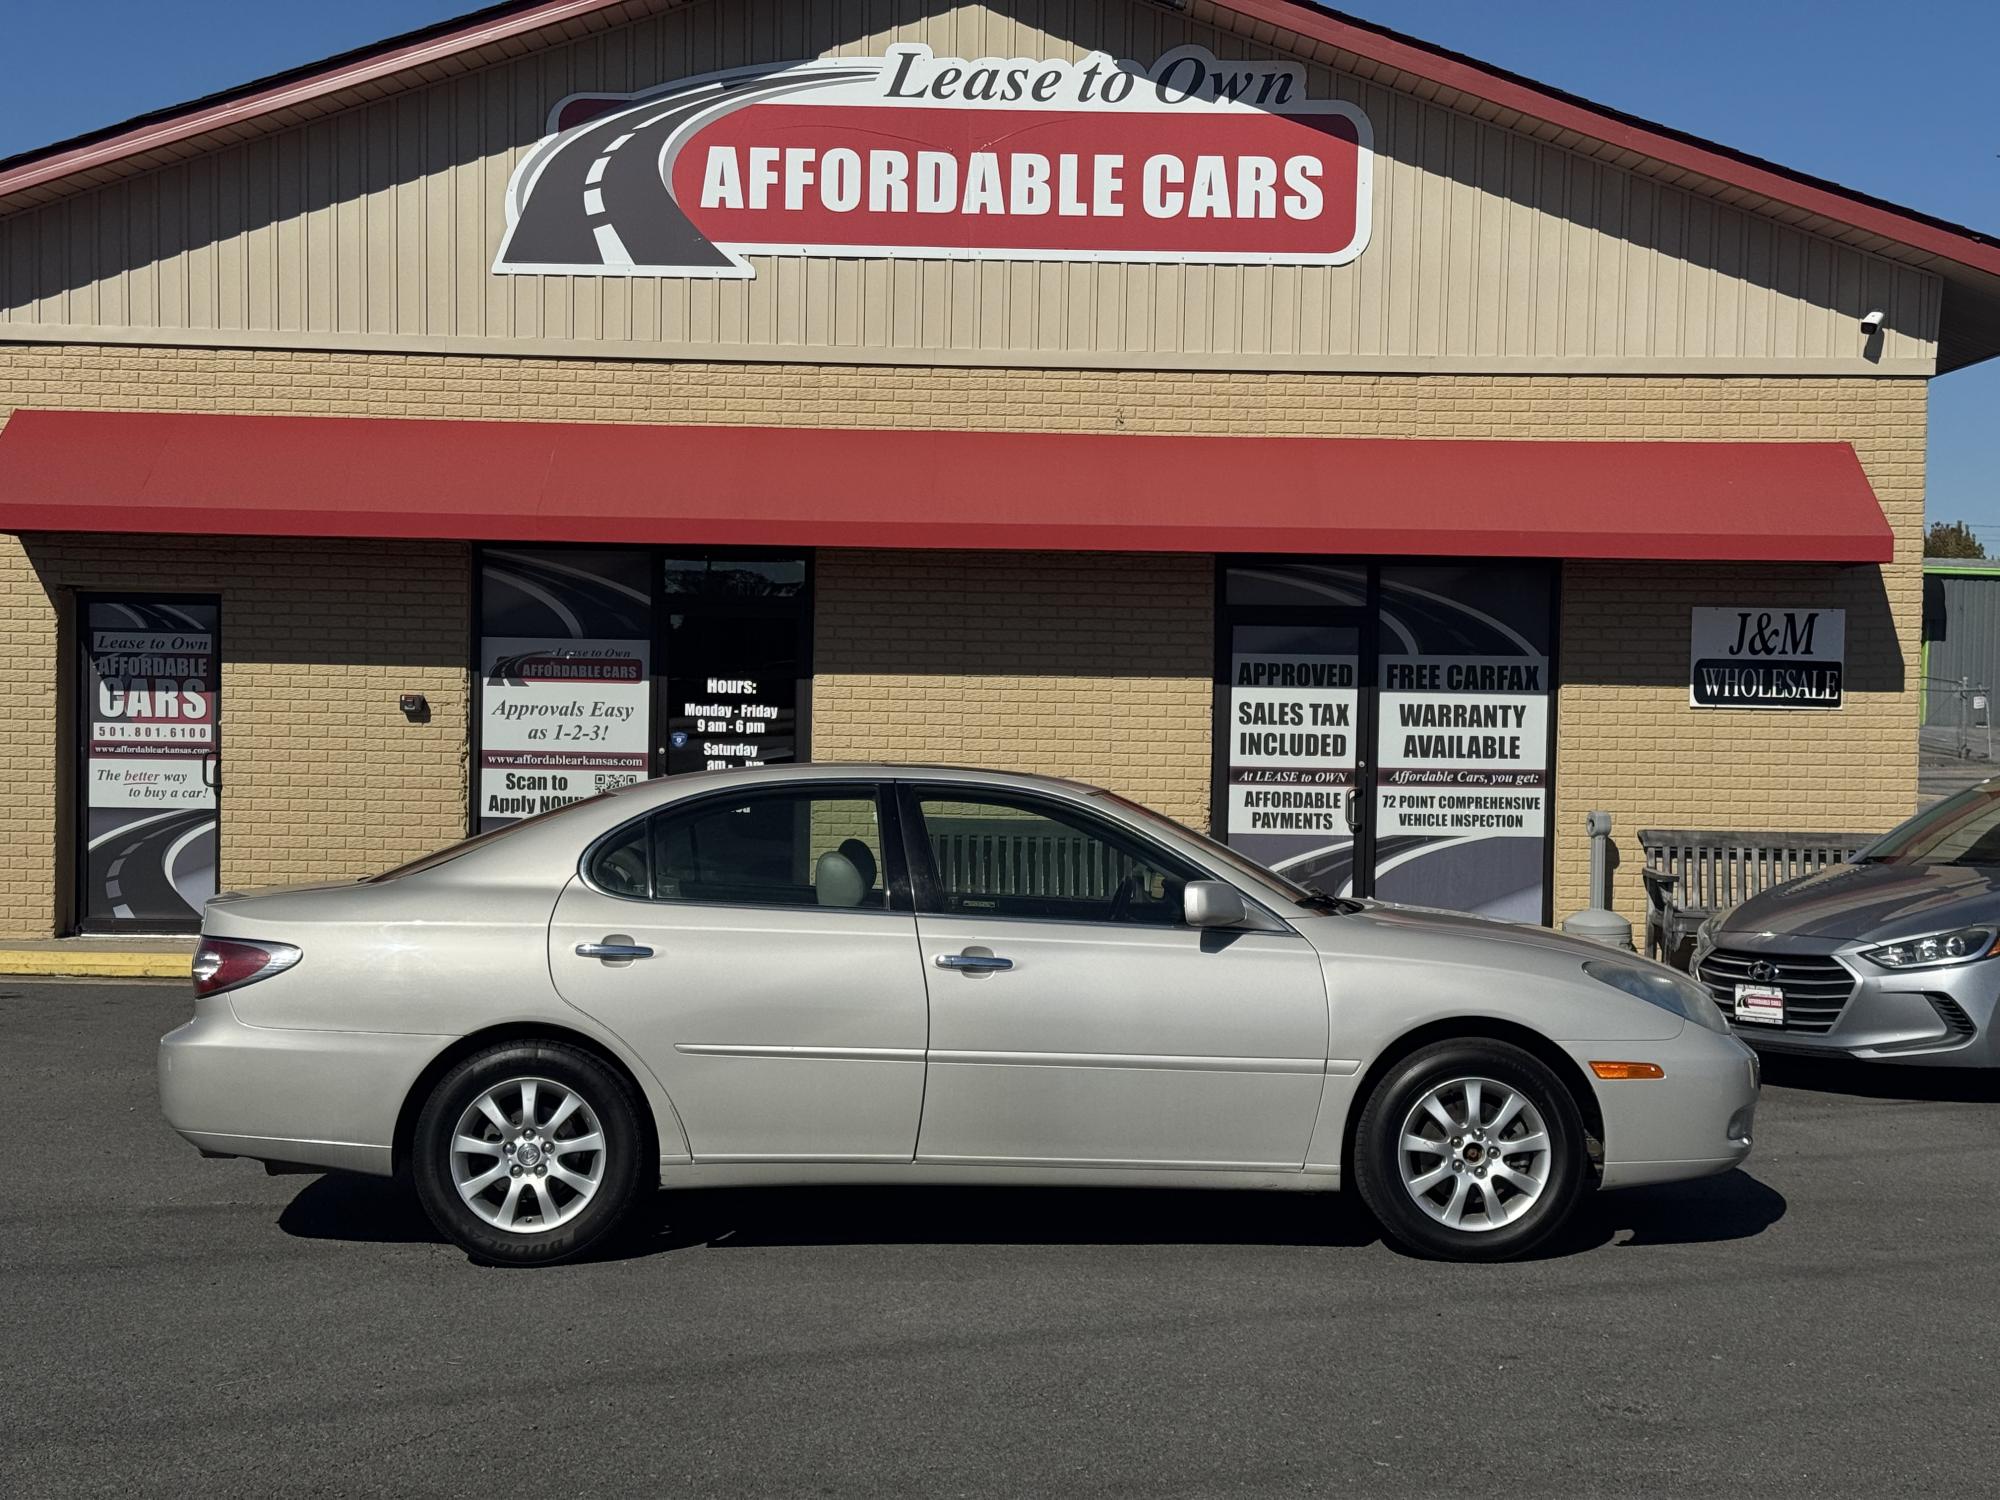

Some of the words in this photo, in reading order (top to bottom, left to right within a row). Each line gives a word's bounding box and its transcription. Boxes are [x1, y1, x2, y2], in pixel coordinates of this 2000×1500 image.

[884, 52, 1062, 101] Lease
[1078, 61, 1134, 103] to
[1156, 63, 1297, 105] Own
[700, 146, 1124, 217] AFFORDABLE
[1142, 154, 1324, 220] CARS
[97, 635, 145, 649] Lease
[150, 638, 165, 649] to
[171, 637, 208, 650] Own
[1729, 612, 1819, 656] J&M
[556, 647, 589, 657] Lease
[591, 648, 602, 657] to
[605, 648, 631, 657] Own
[98, 656, 208, 677] AFFORDABLE
[522, 664, 601, 678] AFFORDABLE
[603, 665, 637, 679] CARS
[1238, 662, 1353, 688] APPROVED
[707, 678, 757, 694] Hours:
[1386, 664, 1440, 690] FREE
[1447, 664, 1539, 691] CARFAX
[1701, 667, 1838, 700] WHOLESALE
[99, 677, 207, 719] CARS
[491, 699, 585, 721] Approvals
[589, 701, 634, 721] Easy
[684, 703, 732, 718] Monday
[741, 704, 778, 719] Friday
[1238, 701, 1304, 726] SALES
[1310, 702, 1349, 727] TAX
[1399, 703, 1527, 729] WARRANTY
[99, 726, 207, 738] 501.801.6100
[528, 726, 547, 740] as
[553, 724, 609, 741] 1-2-3!
[697, 720, 705, 732] 9
[707, 722, 726, 733] am
[735, 721, 743, 733] 6
[745, 722, 765, 735] pm
[95, 745, 210, 754] www.affordablearkansas.com
[703, 743, 758, 757] Saturday
[1239, 732, 1347, 757] INCLUDED
[1403, 735, 1521, 760] AVAILABLE
[487, 754, 643, 767] www.affordablearkansas.com
[97, 769, 121, 781] The
[124, 770, 160, 782] better
[164, 773, 188, 784] way
[506, 773, 547, 791] Scan
[551, 774, 568, 791] to
[1239, 771, 1254, 782] At
[1256, 771, 1298, 783] LEASE
[1301, 772, 1312, 783] to
[1315, 771, 1348, 783] OWN
[1390, 770, 1454, 784] Affordable
[1457, 771, 1488, 785] Cars,
[1490, 773, 1512, 785] you
[1516, 772, 1539, 786] get:
[129, 787, 141, 797] to
[144, 786, 167, 800] buy
[171, 790, 178, 798] a
[182, 788, 208, 798] car!
[1244, 790, 1341, 808] AFFORDABLE
[488, 795, 536, 814] Apply
[1382, 795, 1397, 808] 72
[1399, 796, 1436, 809] POINT
[1439, 796, 1541, 811] COMPREHENSIVE
[1252, 812, 1333, 830] PAYMENTS
[1399, 813, 1448, 828] VEHICLE
[1450, 814, 1523, 829] INSPECTION
